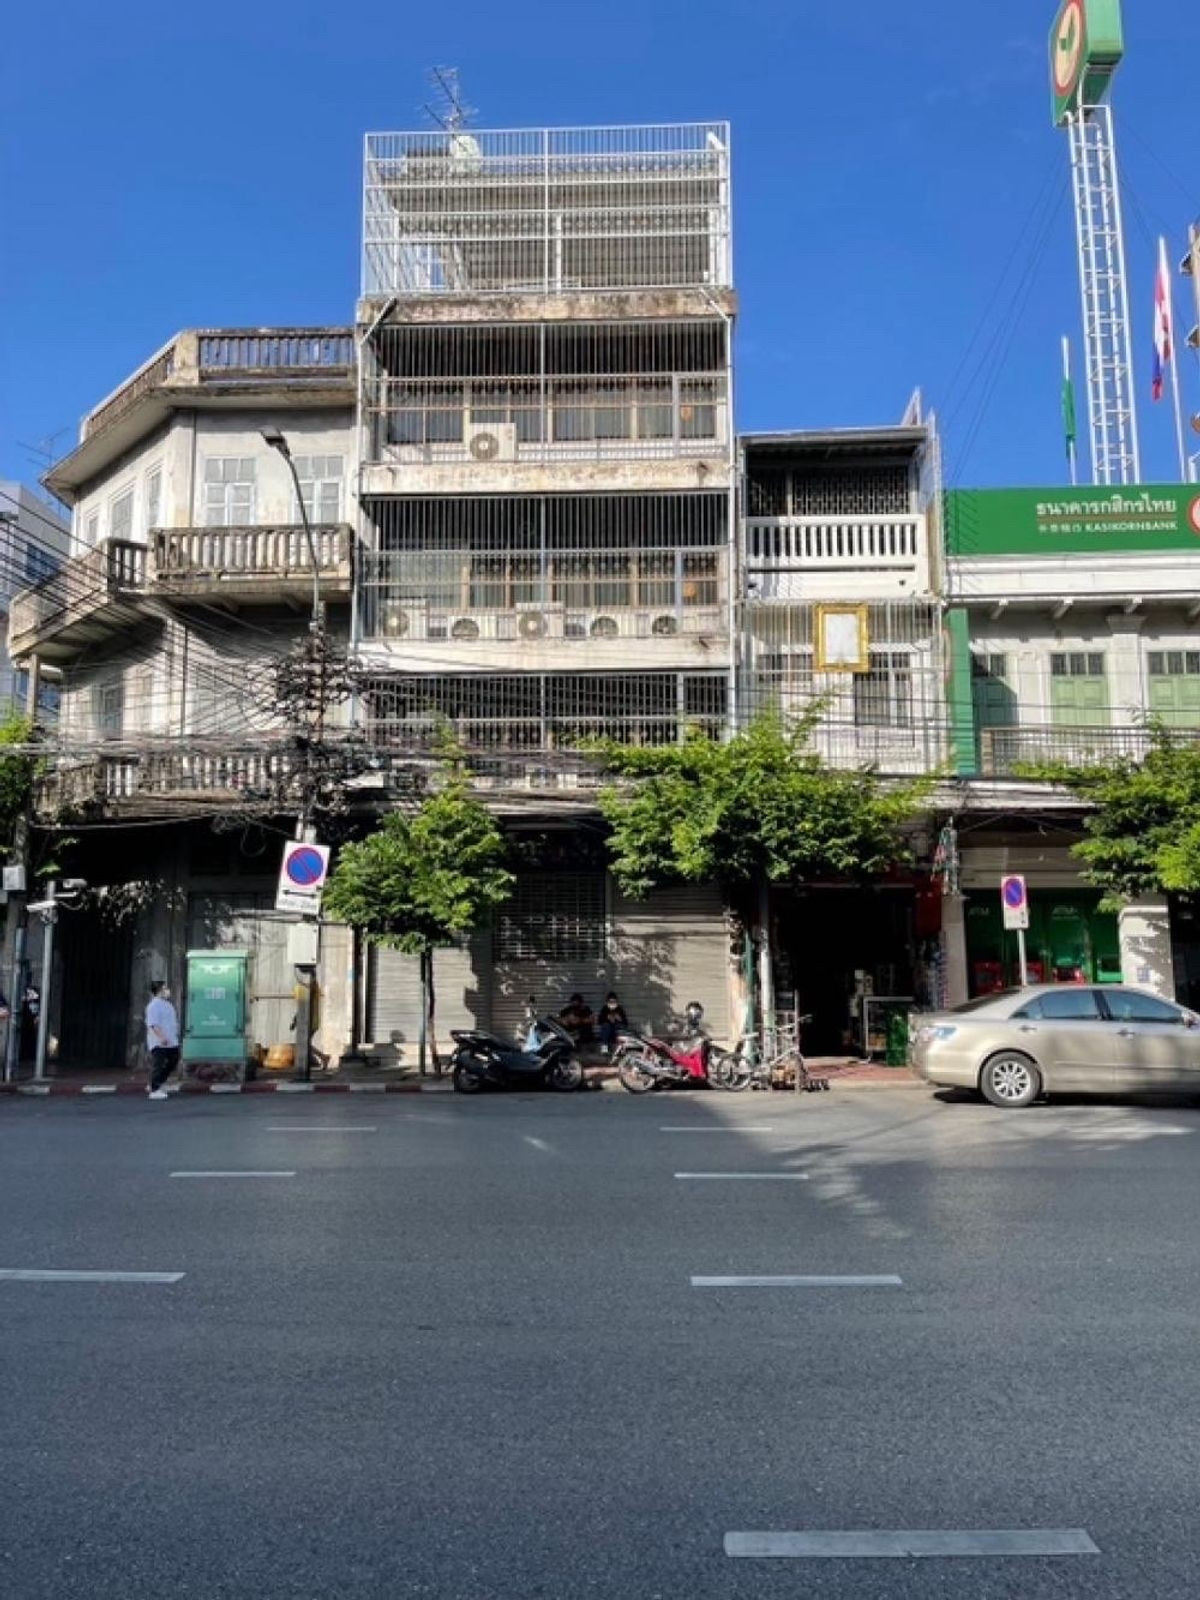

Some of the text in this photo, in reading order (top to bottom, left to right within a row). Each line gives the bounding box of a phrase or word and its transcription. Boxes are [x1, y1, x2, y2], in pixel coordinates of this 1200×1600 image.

[1036, 493, 1176, 515] ธนาคารกสิกรไทย
[1085, 521, 1177, 532] KASIKORNBANK
